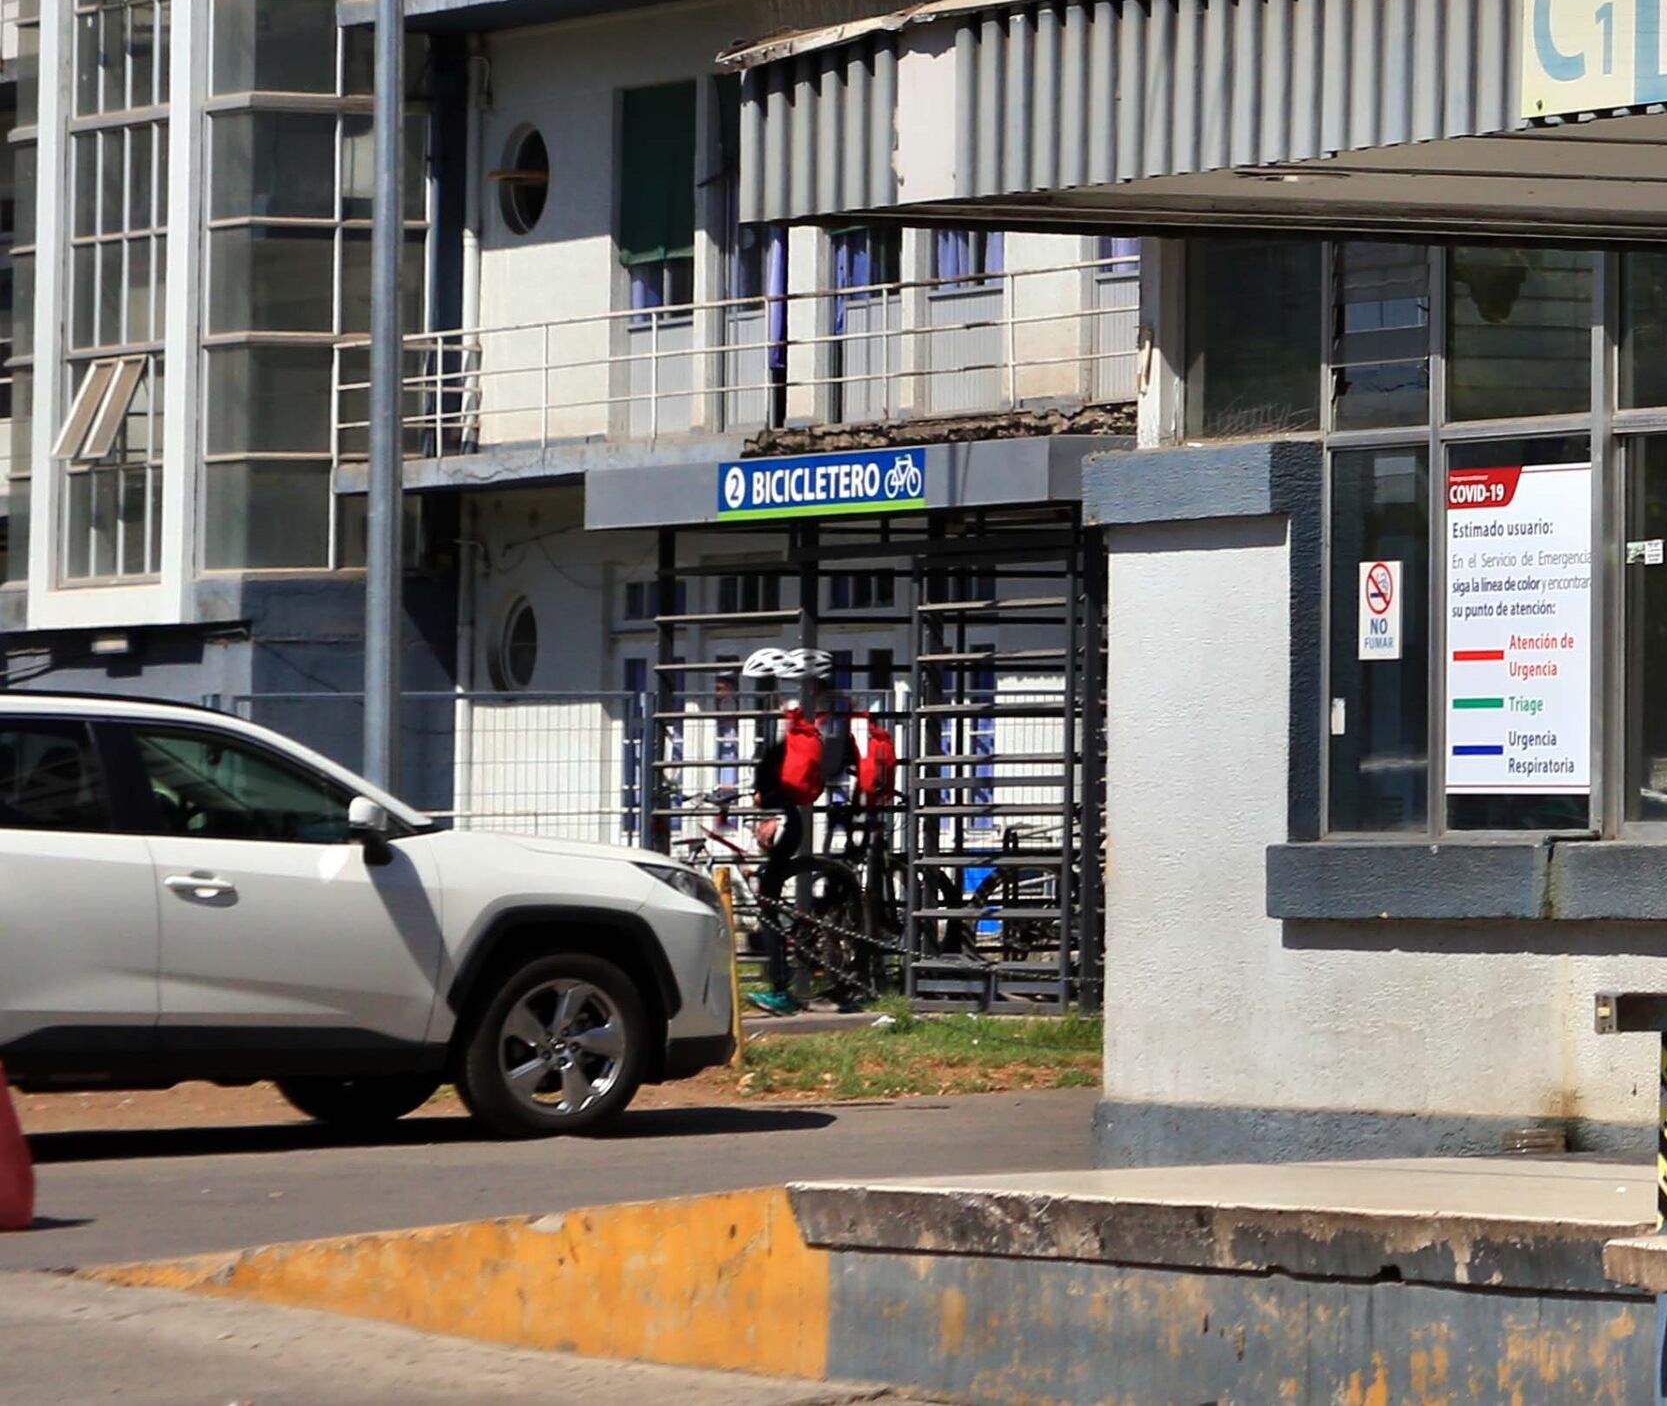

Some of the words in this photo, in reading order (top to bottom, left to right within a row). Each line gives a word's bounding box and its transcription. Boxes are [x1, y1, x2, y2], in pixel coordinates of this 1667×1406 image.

[752, 462, 880, 505] BICICLETERO
[1449, 483, 1505, 504] COVID-19
[1452, 519, 1504, 539] Estimado
[1506, 517, 1553, 537] usuario:
[1452, 554, 1464, 569] En
[1468, 553, 1477, 568] el
[1481, 551, 1517, 569] Servicio
[1521, 551, 1534, 566] de
[1452, 578, 1470, 597] siga
[1471, 577, 1480, 593] la
[1504, 575, 1516, 592] de
[1517, 574, 1540, 592] color
[1540, 579, 1547, 595] y
[1451, 605, 1463, 619] su
[1464, 602, 1494, 622] punto
[1496, 600, 1508, 616] de
[1510, 598, 1556, 616] atención:
[1369, 617, 1389, 635] NO
[1363, 637, 1394, 650] FUMAR
[1508, 632, 1559, 651] Atención
[1560, 632, 1575, 650] de
[1508, 660, 1558, 681] Urgencia
[1508, 695, 1544, 716] Triage
[1508, 730, 1557, 751] Urgencia
[1507, 757, 1575, 778] Respiratoria
